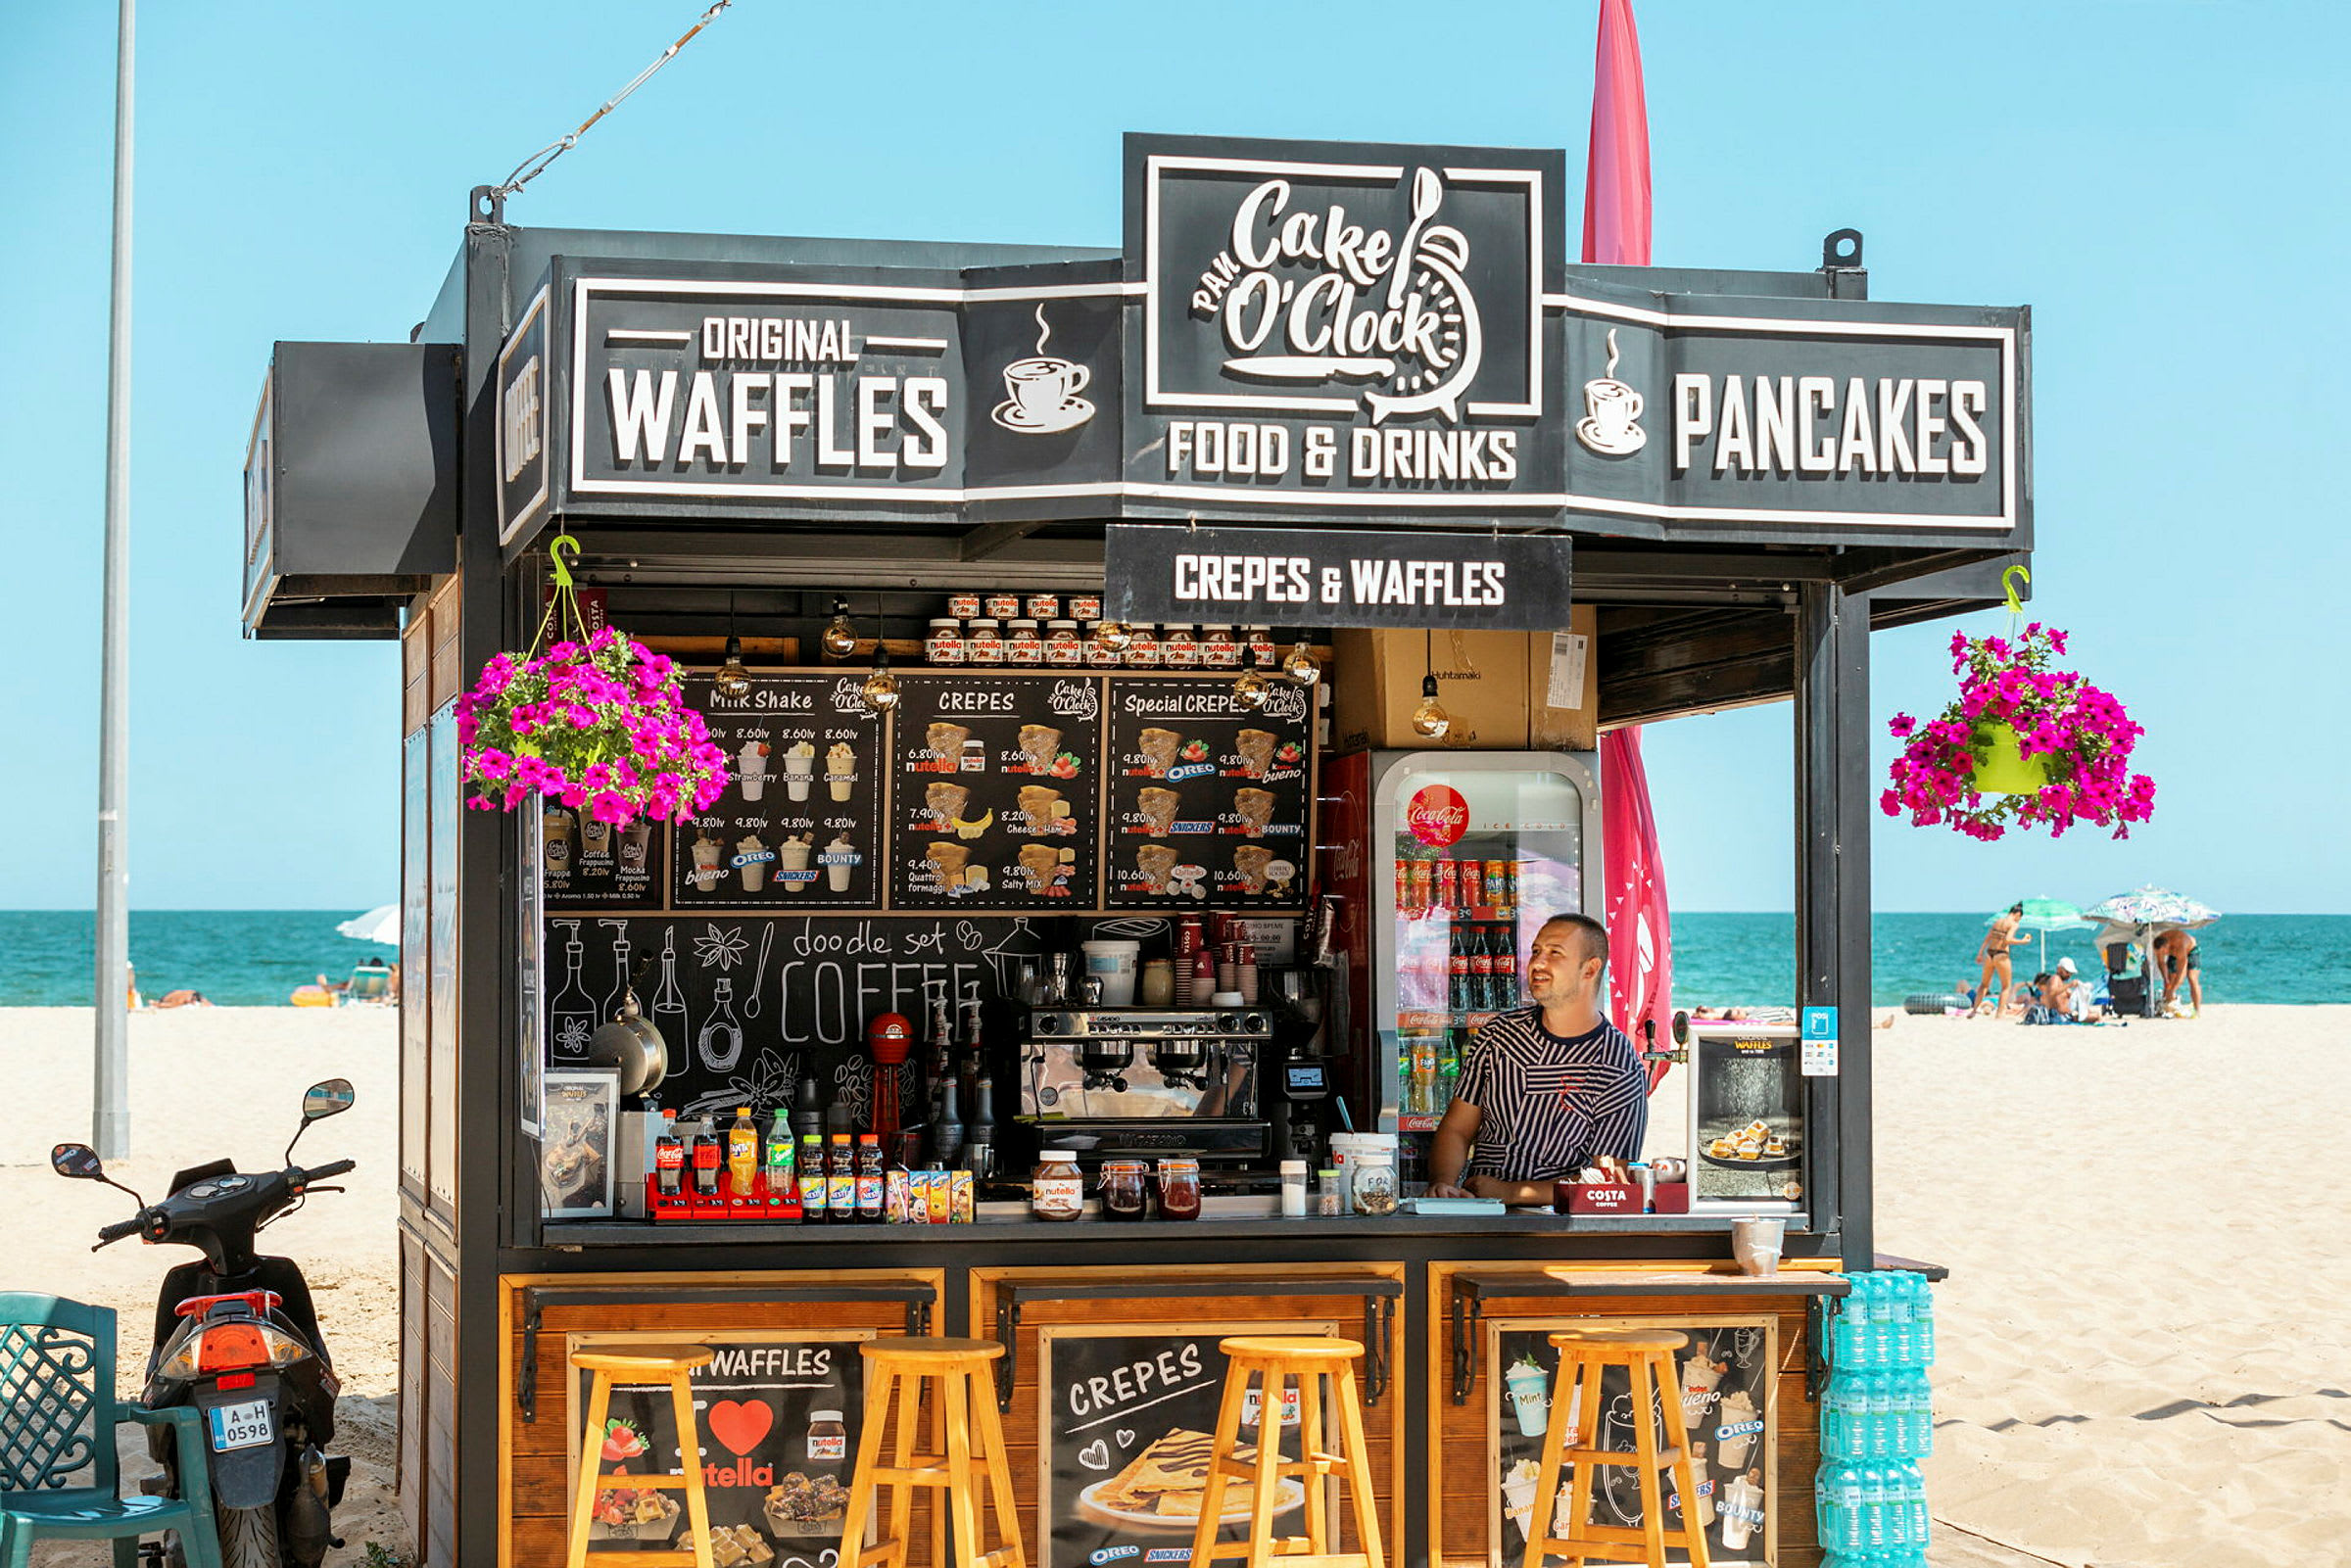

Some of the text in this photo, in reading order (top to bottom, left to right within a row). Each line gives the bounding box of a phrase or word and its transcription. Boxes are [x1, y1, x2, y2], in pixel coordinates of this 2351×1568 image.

[1233, 180, 1394, 285] Cake
[1193, 251, 1240, 312] PAN
[1225, 271, 1450, 368] O'Clock
[702, 317, 859, 361] ORIGINAL
[608, 369, 947, 466] WAFFLES
[1674, 373, 1987, 475] PANCAKES
[1168, 422, 1516, 482] FOOD & DRINKS
[1175, 553, 1505, 606] CREPES & WAFFLES
[591, 599, 600, 632] OSTA
[931, 641, 962, 649] nutella
[970, 641, 1001, 649] nutella
[1009, 641, 1040, 650] nutella
[1047, 641, 1079, 650] nutella
[1166, 642, 1196, 651] nutella
[1205, 643, 1234, 652] nutella
[1432, 671, 1480, 680] Huhtamaki
[755, 689, 812, 709] Shake
[938, 691, 1015, 710] CREPES
[1125, 694, 1181, 717] Special
[736, 728, 770, 739] 8.60lv
[782, 728, 816, 739] 8.60lv
[825, 729, 858, 739] 8.60lv
[906, 759, 957, 773] nutella
[1168, 764, 1215, 780] OREO
[784, 773, 814, 783] Banana
[1263, 769, 1301, 784] bueno
[1412, 805, 1465, 826] Coca-Cola
[692, 817, 725, 828] 9.80lv
[735, 817, 768, 828] 9.80lv
[781, 817, 814, 829] 9.80lv
[824, 818, 857, 829] 9.80lv
[1007, 824, 1036, 833] Cheese
[1170, 822, 1213, 832] SNICKERS
[1262, 825, 1301, 833] BOUNTY
[733, 851, 775, 867] OREO
[817, 853, 861, 864] BOUNTY
[685, 868, 729, 885] bueno
[777, 871, 817, 881] SNICKERS
[908, 872, 940, 883] Quattro
[1001, 879, 1024, 890] Salty
[793, 917, 946, 957] doodle set
[1735, 1041, 1772, 1050] WAFFLES
[1045, 1187, 1076, 1196] nutella
[1587, 1190, 1626, 1202] COSTA
[709, 1348, 831, 1377] WAFFLES
[1070, 1343, 1203, 1416] CREPES
[1519, 1393, 1541, 1405] Mint
[1682, 1391, 1721, 1407] ueno
[231, 1405, 265, 1424] A H
[227, 1423, 268, 1442] 0598
[1717, 1420, 1763, 1439] OREO
[812, 1437, 843, 1447] nutella
[1716, 1500, 1765, 1521] BOUNTY
[1091, 1545, 1138, 1564] OREO
[1147, 1548, 1193, 1561] SNICKERS
